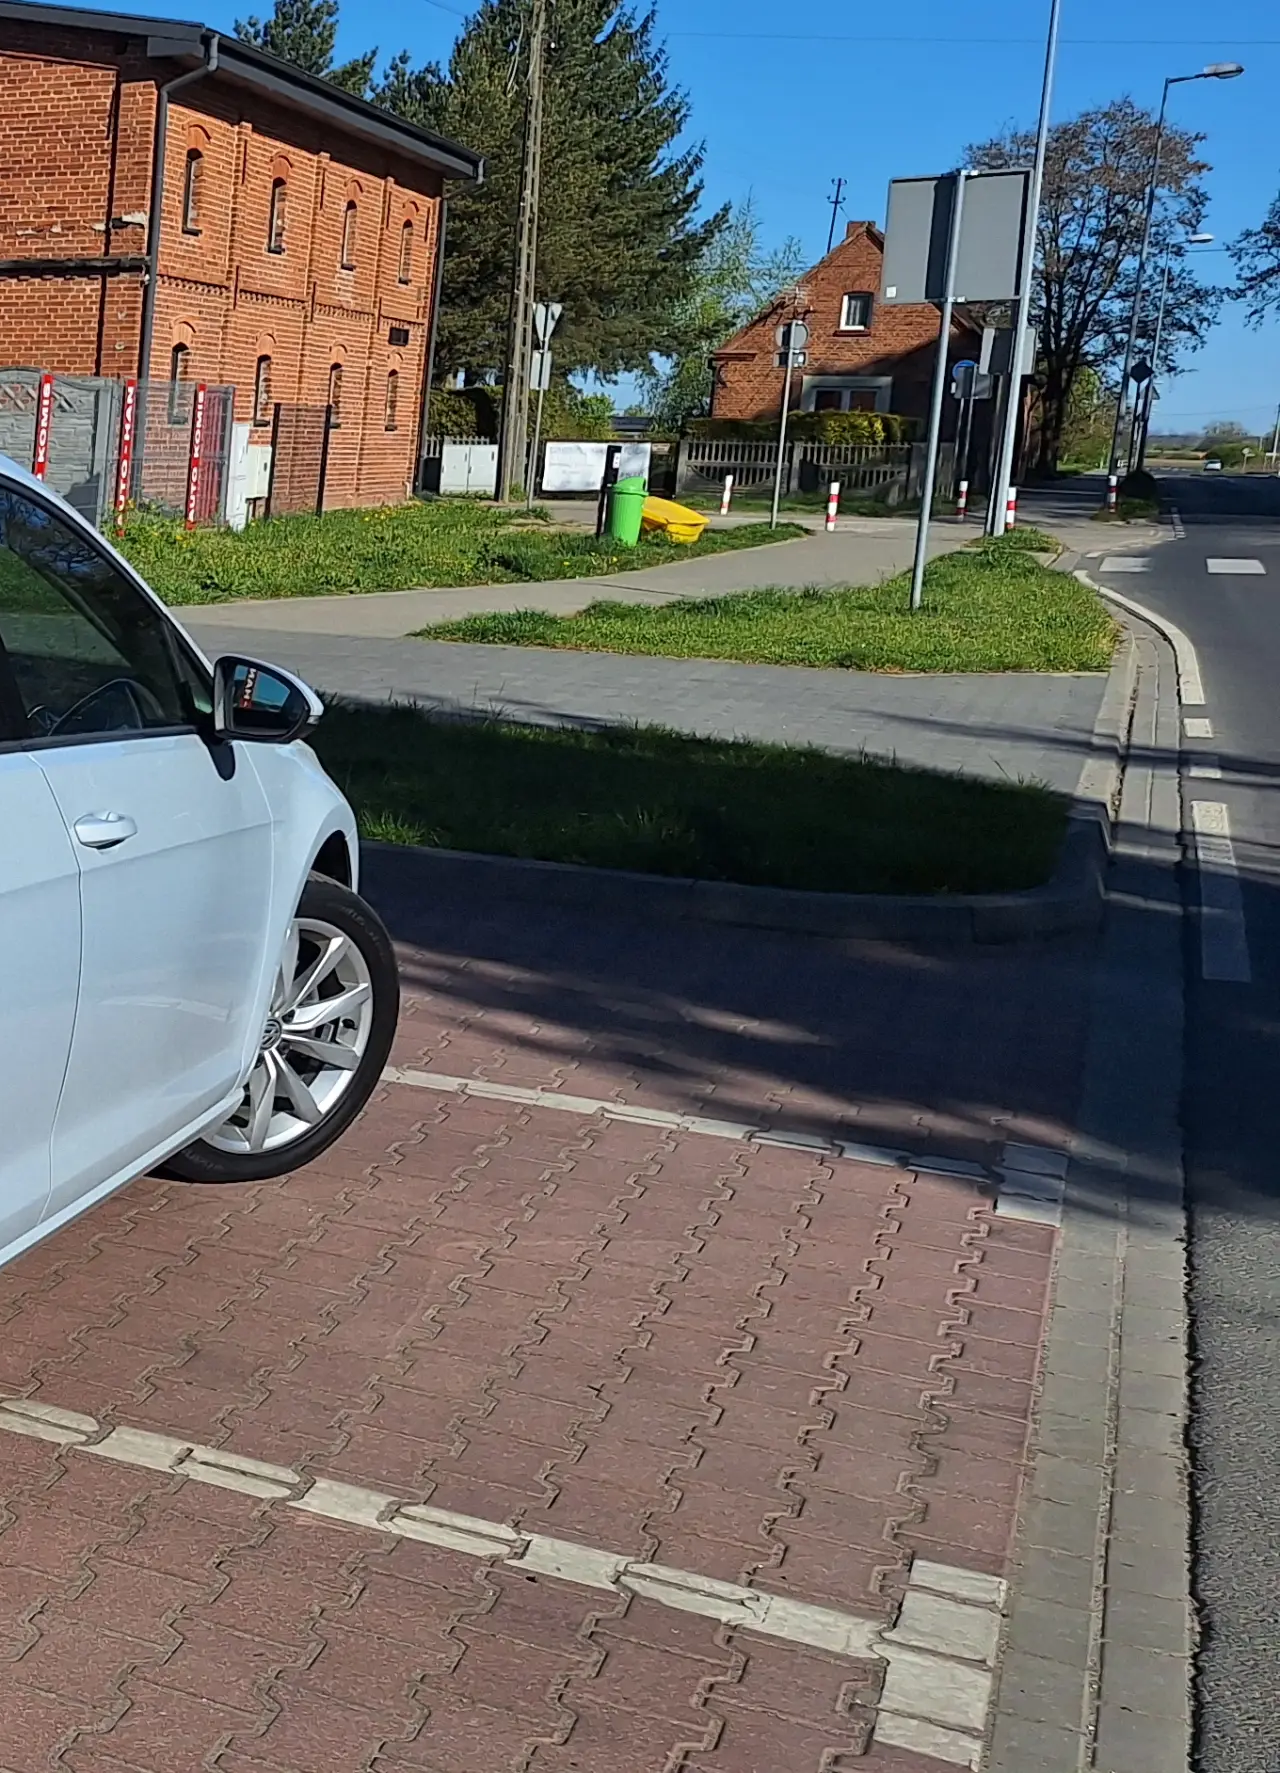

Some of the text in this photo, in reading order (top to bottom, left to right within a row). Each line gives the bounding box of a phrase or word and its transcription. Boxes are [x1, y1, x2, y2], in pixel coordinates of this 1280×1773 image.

[37, 382, 51, 463] KOMIS
[188, 391, 205, 522] AUTO KOMIS
